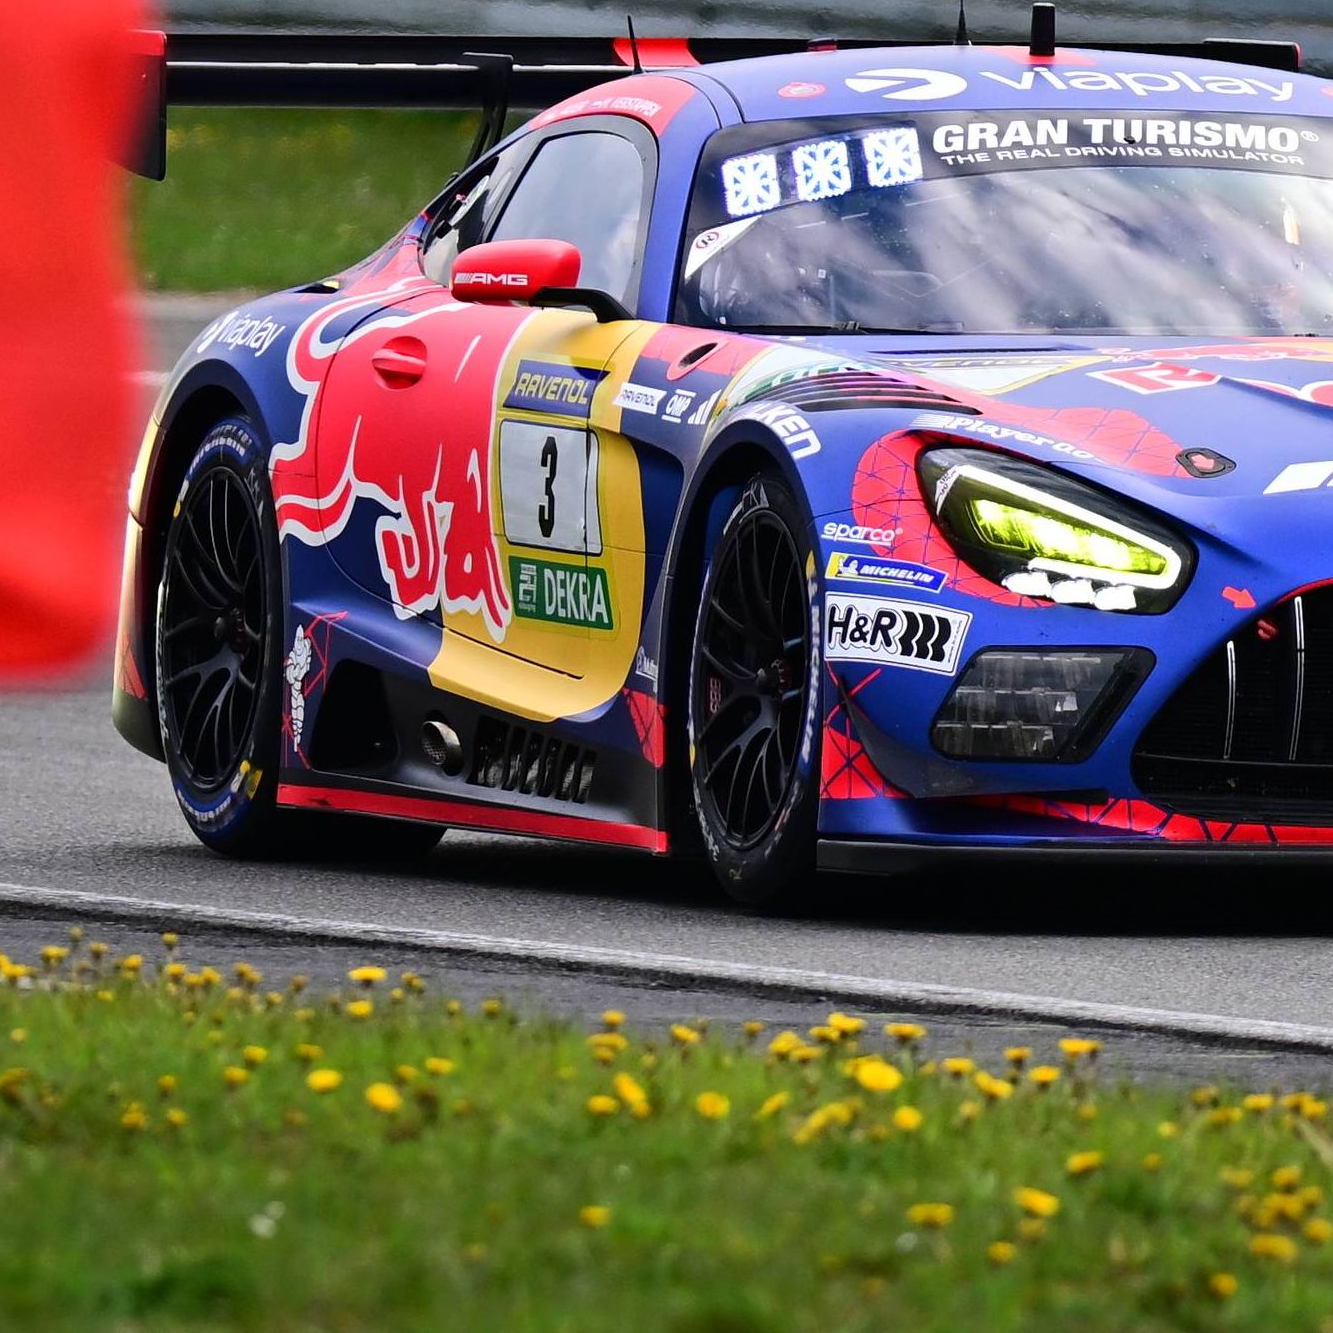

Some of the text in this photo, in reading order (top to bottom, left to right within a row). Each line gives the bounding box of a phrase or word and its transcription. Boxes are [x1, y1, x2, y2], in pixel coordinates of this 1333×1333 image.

[979, 67, 1294, 101] viaplay
[932, 119, 1068, 154] GRAN
[941, 145, 1306, 166] THE REAL DRIVING SIMULATOR
[470, 272, 528, 286] AMG
[218, 313, 286, 358] viaplay
[514, 372, 590, 405] RAVENOL
[620, 389, 657, 408] RAVENOL
[666, 394, 691, 416] OMP
[538, 436, 558, 538] 3
[823, 521, 896, 542] sparco
[860, 564, 935, 583] MICHELIN
[544, 568, 609, 624] DEKRA
[828, 605, 897, 648] H&R
